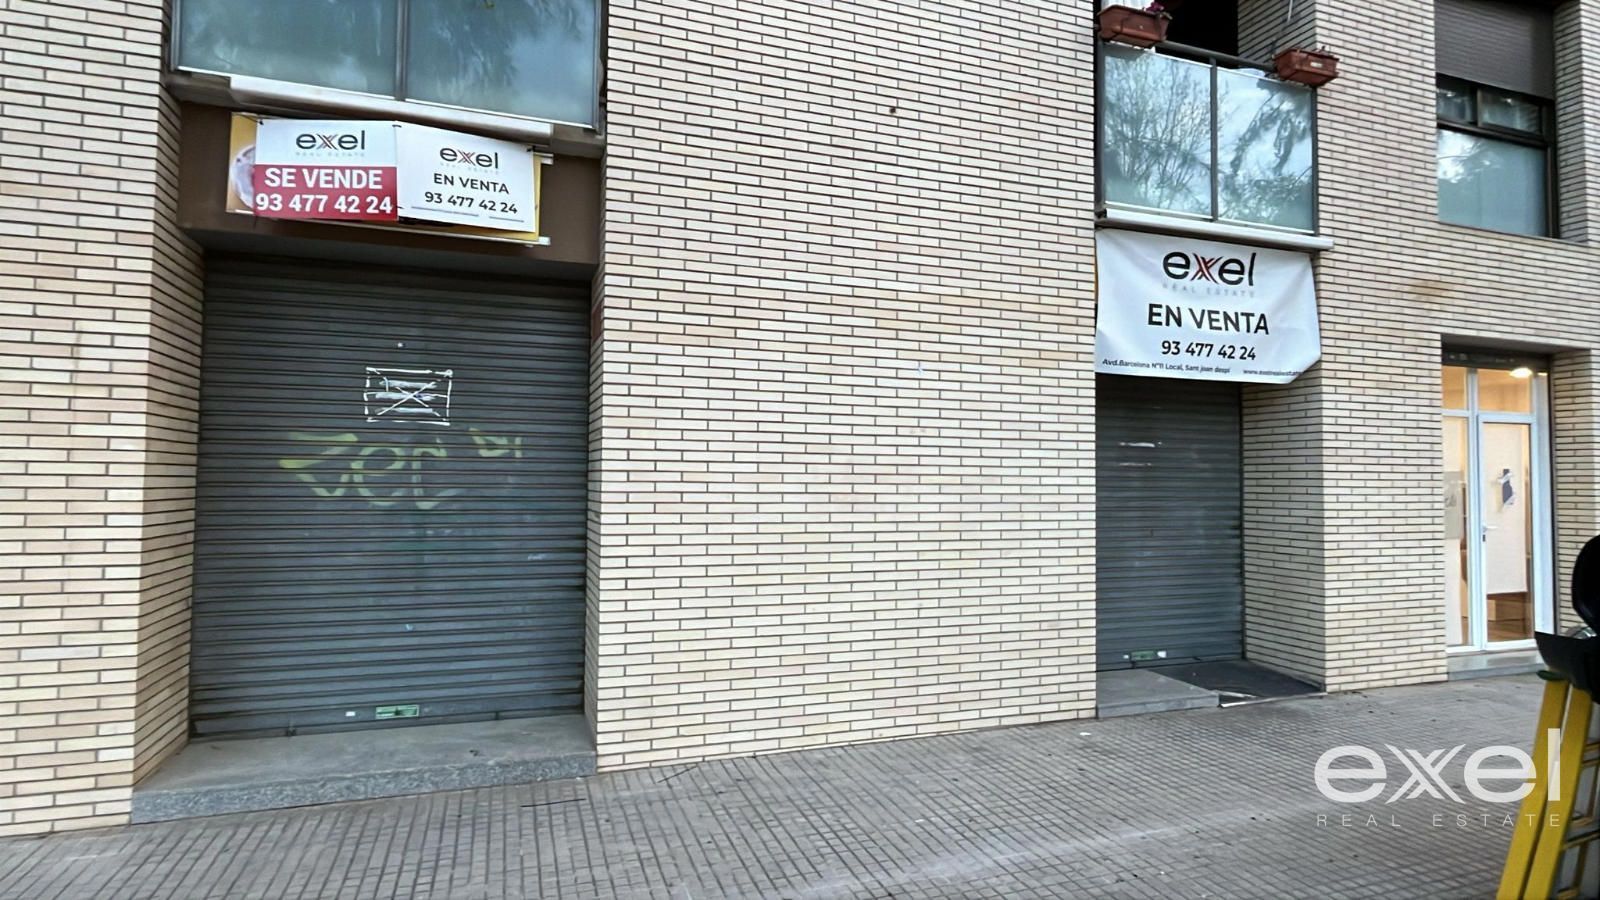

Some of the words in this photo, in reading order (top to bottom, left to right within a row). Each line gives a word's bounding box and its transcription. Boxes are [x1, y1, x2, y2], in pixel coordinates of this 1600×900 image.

[296, 129, 366, 151] exel
[438, 147, 500, 170] exel
[264, 167, 297, 189] SE
[301, 167, 384, 190] VENDE
[433, 172, 455, 188] EN
[458, 177, 510, 195] VENTA
[255, 193, 284, 213] 93
[289, 193, 329, 214] 477
[335, 195, 361, 214] 42
[366, 196, 394, 215] 24
[424, 191, 443, 205] 93
[447, 194, 475, 209] 477
[478, 198, 497, 212] 42
[500, 201, 519, 215] 24
[1162, 251, 1257, 287] exel
[1147, 303, 1183, 328] EN
[1188, 307, 1270, 335] VENTA
[1161, 340, 1181, 356] 93
[1185, 342, 1214, 358] 477
[1217, 344, 1236, 360] 42
[1239, 345, 1257, 361] 24
